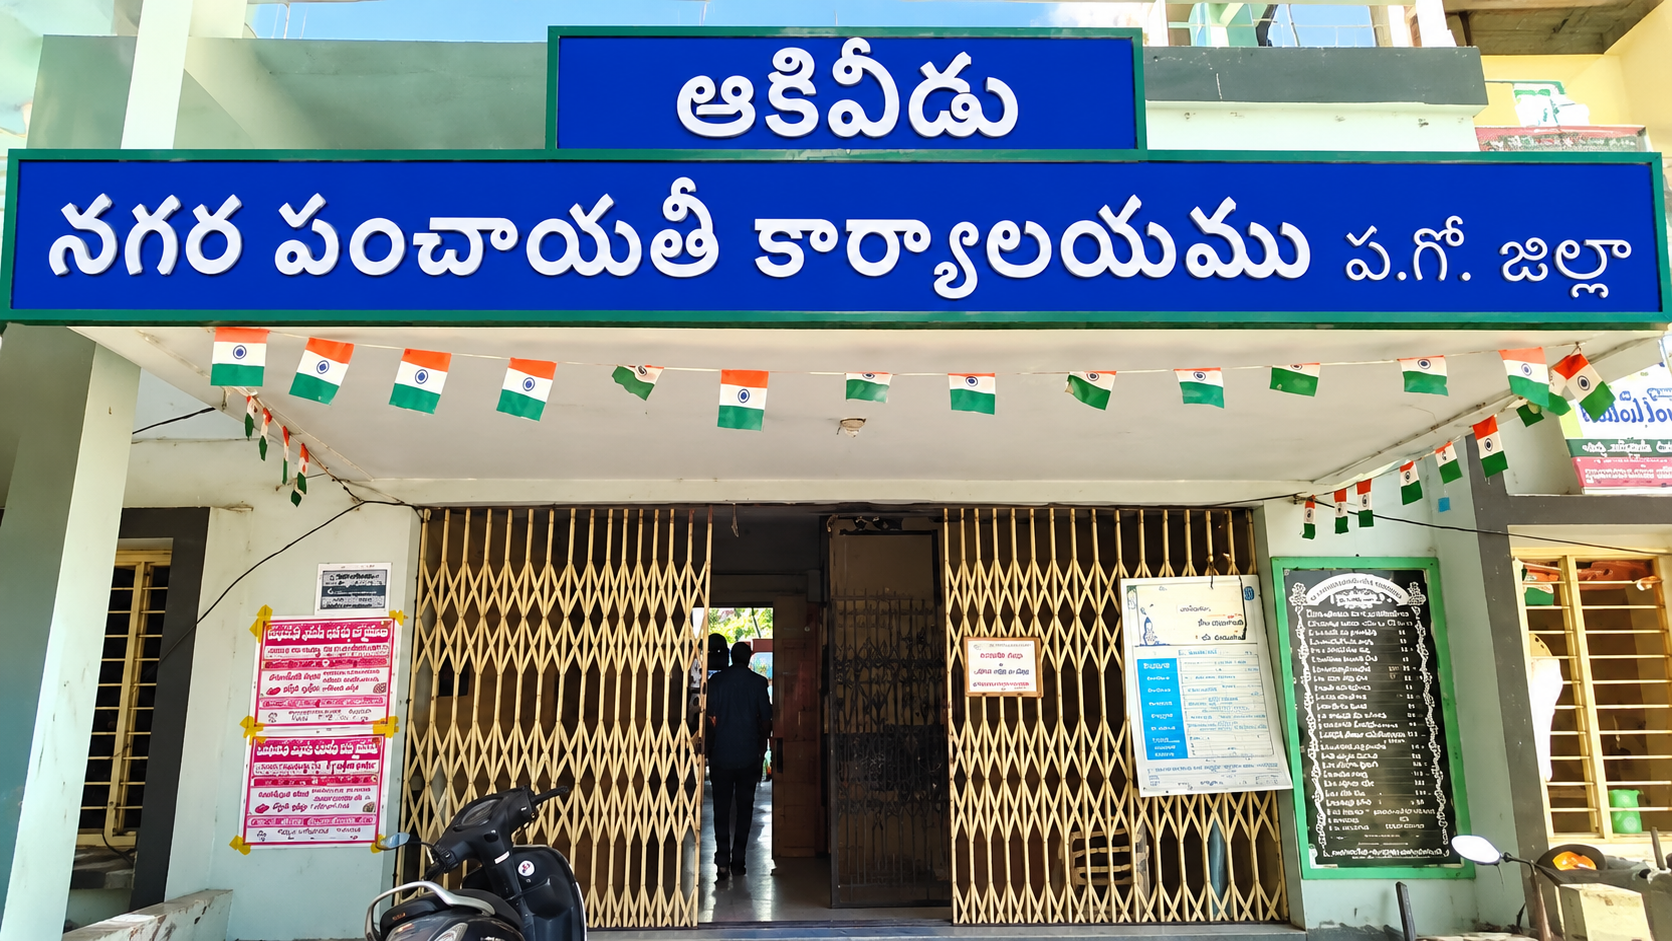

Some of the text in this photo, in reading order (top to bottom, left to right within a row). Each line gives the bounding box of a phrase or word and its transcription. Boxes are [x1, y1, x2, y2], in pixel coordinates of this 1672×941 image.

[677, 37, 1019, 138] ఆకివీడు
[48, 193, 242, 276] నగర
[274, 176, 719, 278] పంచాయతీ
[754, 194, 1311, 299] కార్యాలయము
[1500, 237, 1632, 299] జిల్లా
